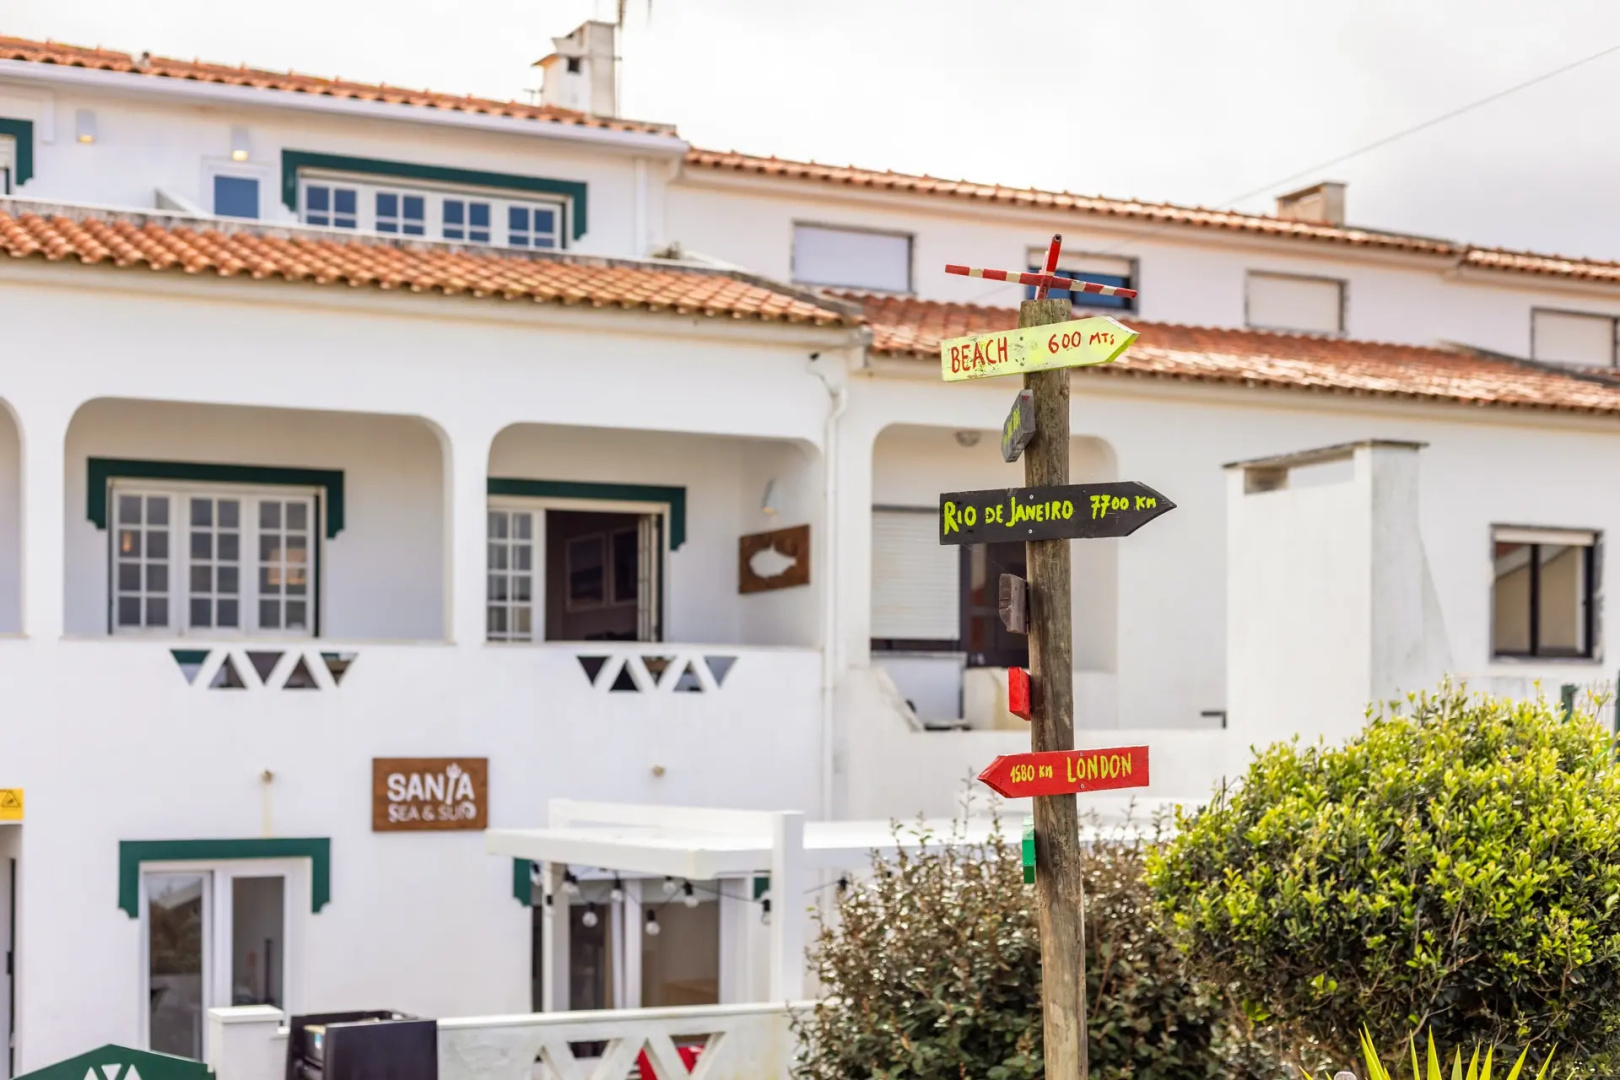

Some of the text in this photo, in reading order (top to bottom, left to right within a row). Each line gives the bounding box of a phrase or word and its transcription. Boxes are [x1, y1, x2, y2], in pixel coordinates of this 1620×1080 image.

[951, 337, 1008, 373] BEACH
[1048, 331, 1082, 354] 600
[985, 504, 1004, 524] DE
[1005, 497, 1073, 527] JANEIRO
[1090, 495, 1129, 519] 7700
[1010, 764, 1035, 783] 1580
[1066, 753, 1132, 783] LONDON
[388, 803, 420, 822] SEA
[422, 804, 436, 821] &
